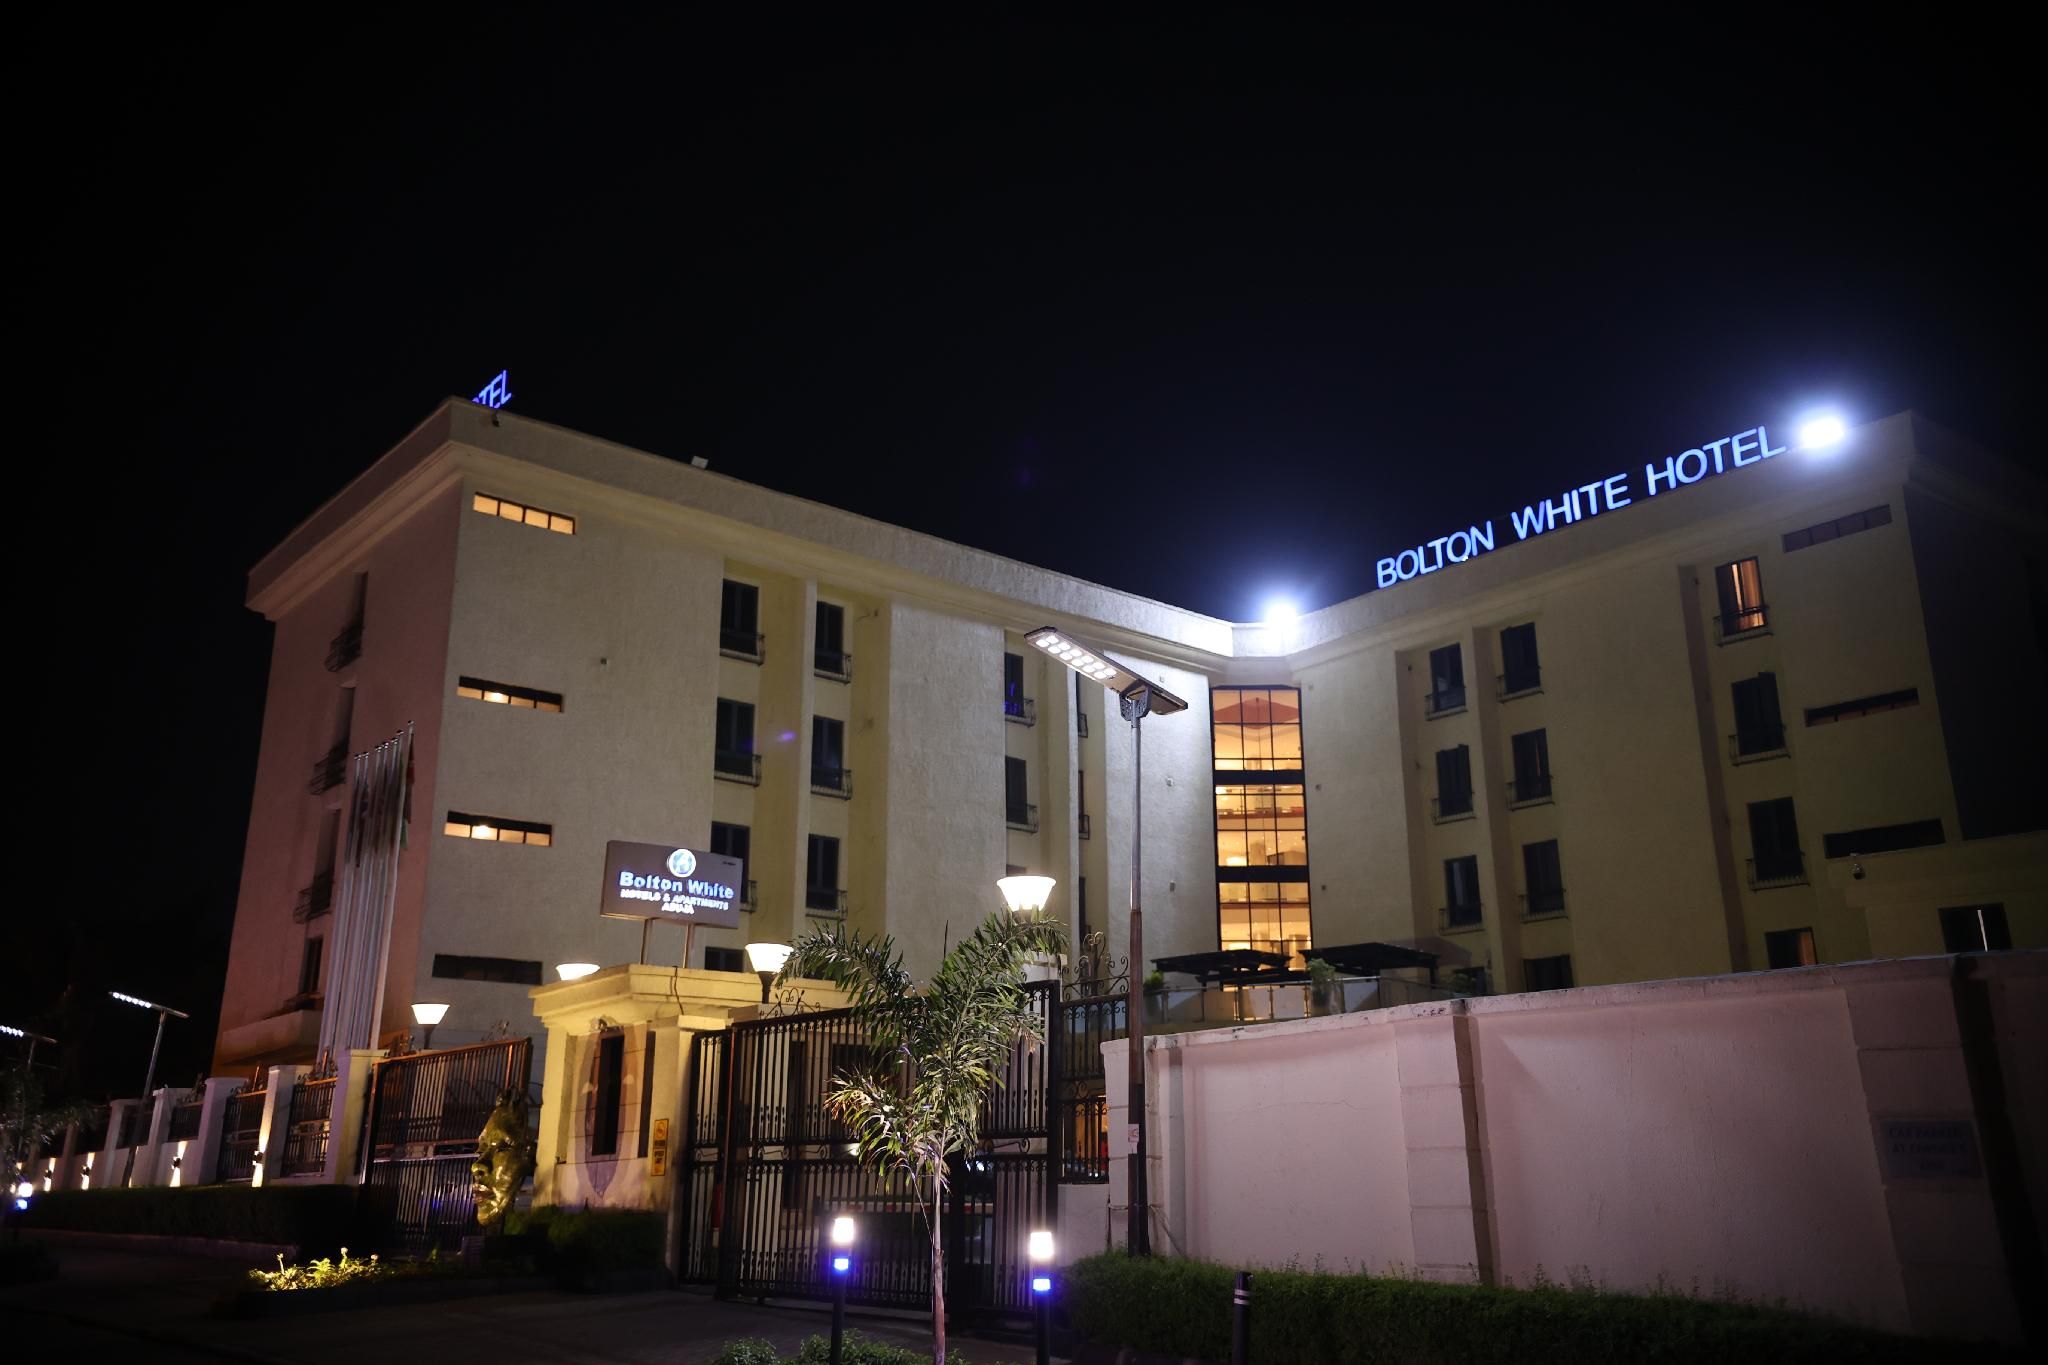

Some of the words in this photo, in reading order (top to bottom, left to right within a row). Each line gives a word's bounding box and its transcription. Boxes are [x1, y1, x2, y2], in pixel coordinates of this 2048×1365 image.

[1377, 521, 1494, 589] BOLTON
[1511, 473, 1631, 540] WHITE
[1645, 425, 1786, 496] HOTEL
[619, 871, 682, 891] Bolton
[688, 879, 734, 899] White
